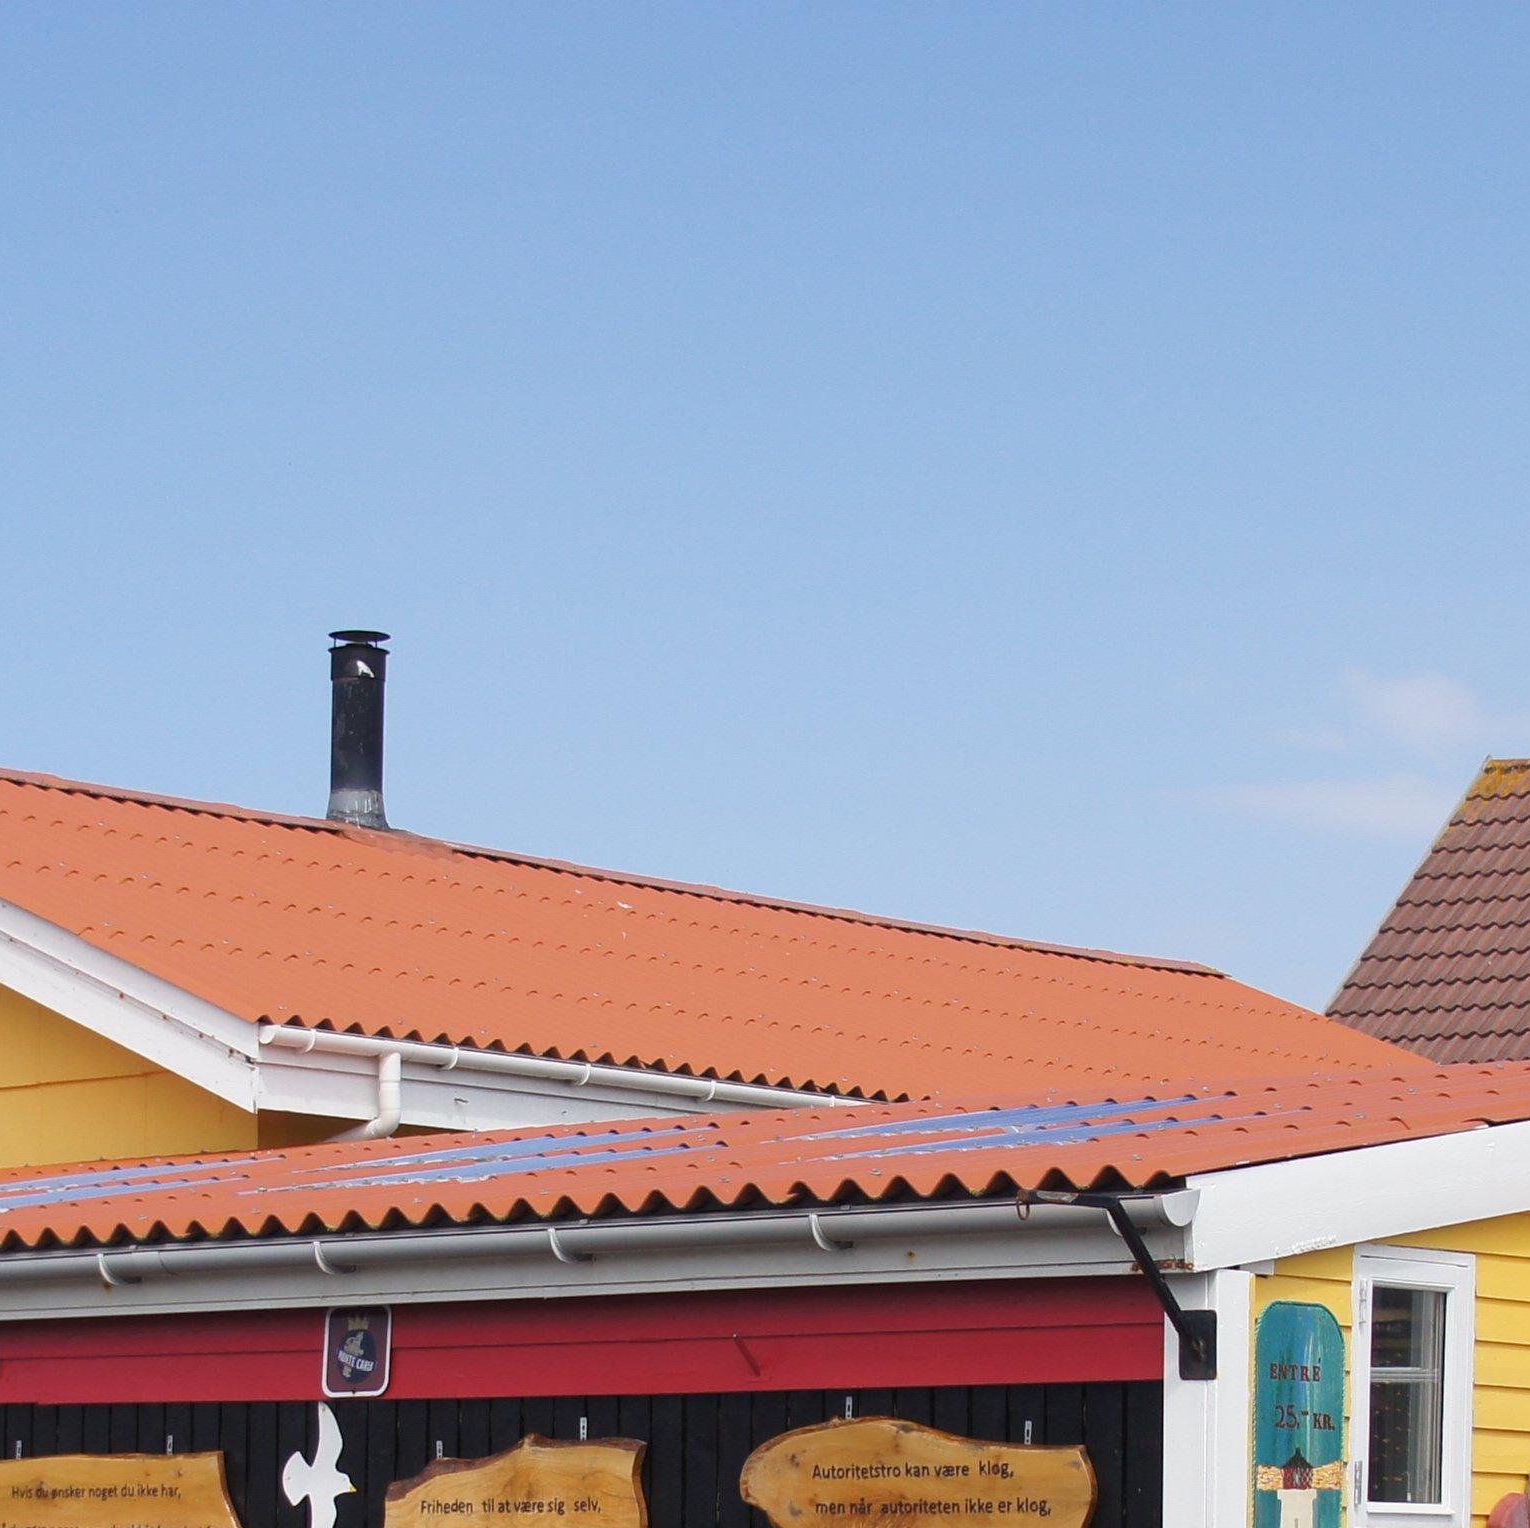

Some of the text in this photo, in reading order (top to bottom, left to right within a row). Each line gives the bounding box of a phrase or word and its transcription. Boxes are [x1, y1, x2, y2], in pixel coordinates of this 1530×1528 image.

[812, 1460, 1014, 1481] Autoritetstro kan være klog,
[11, 1484, 182, 1501] Hvis du ønsker noget du ikke har,
[420, 1496, 601, 1516] Friheden til at være sig selv,
[815, 1498, 1052, 1517] men når autoriteten ikke er klog,
